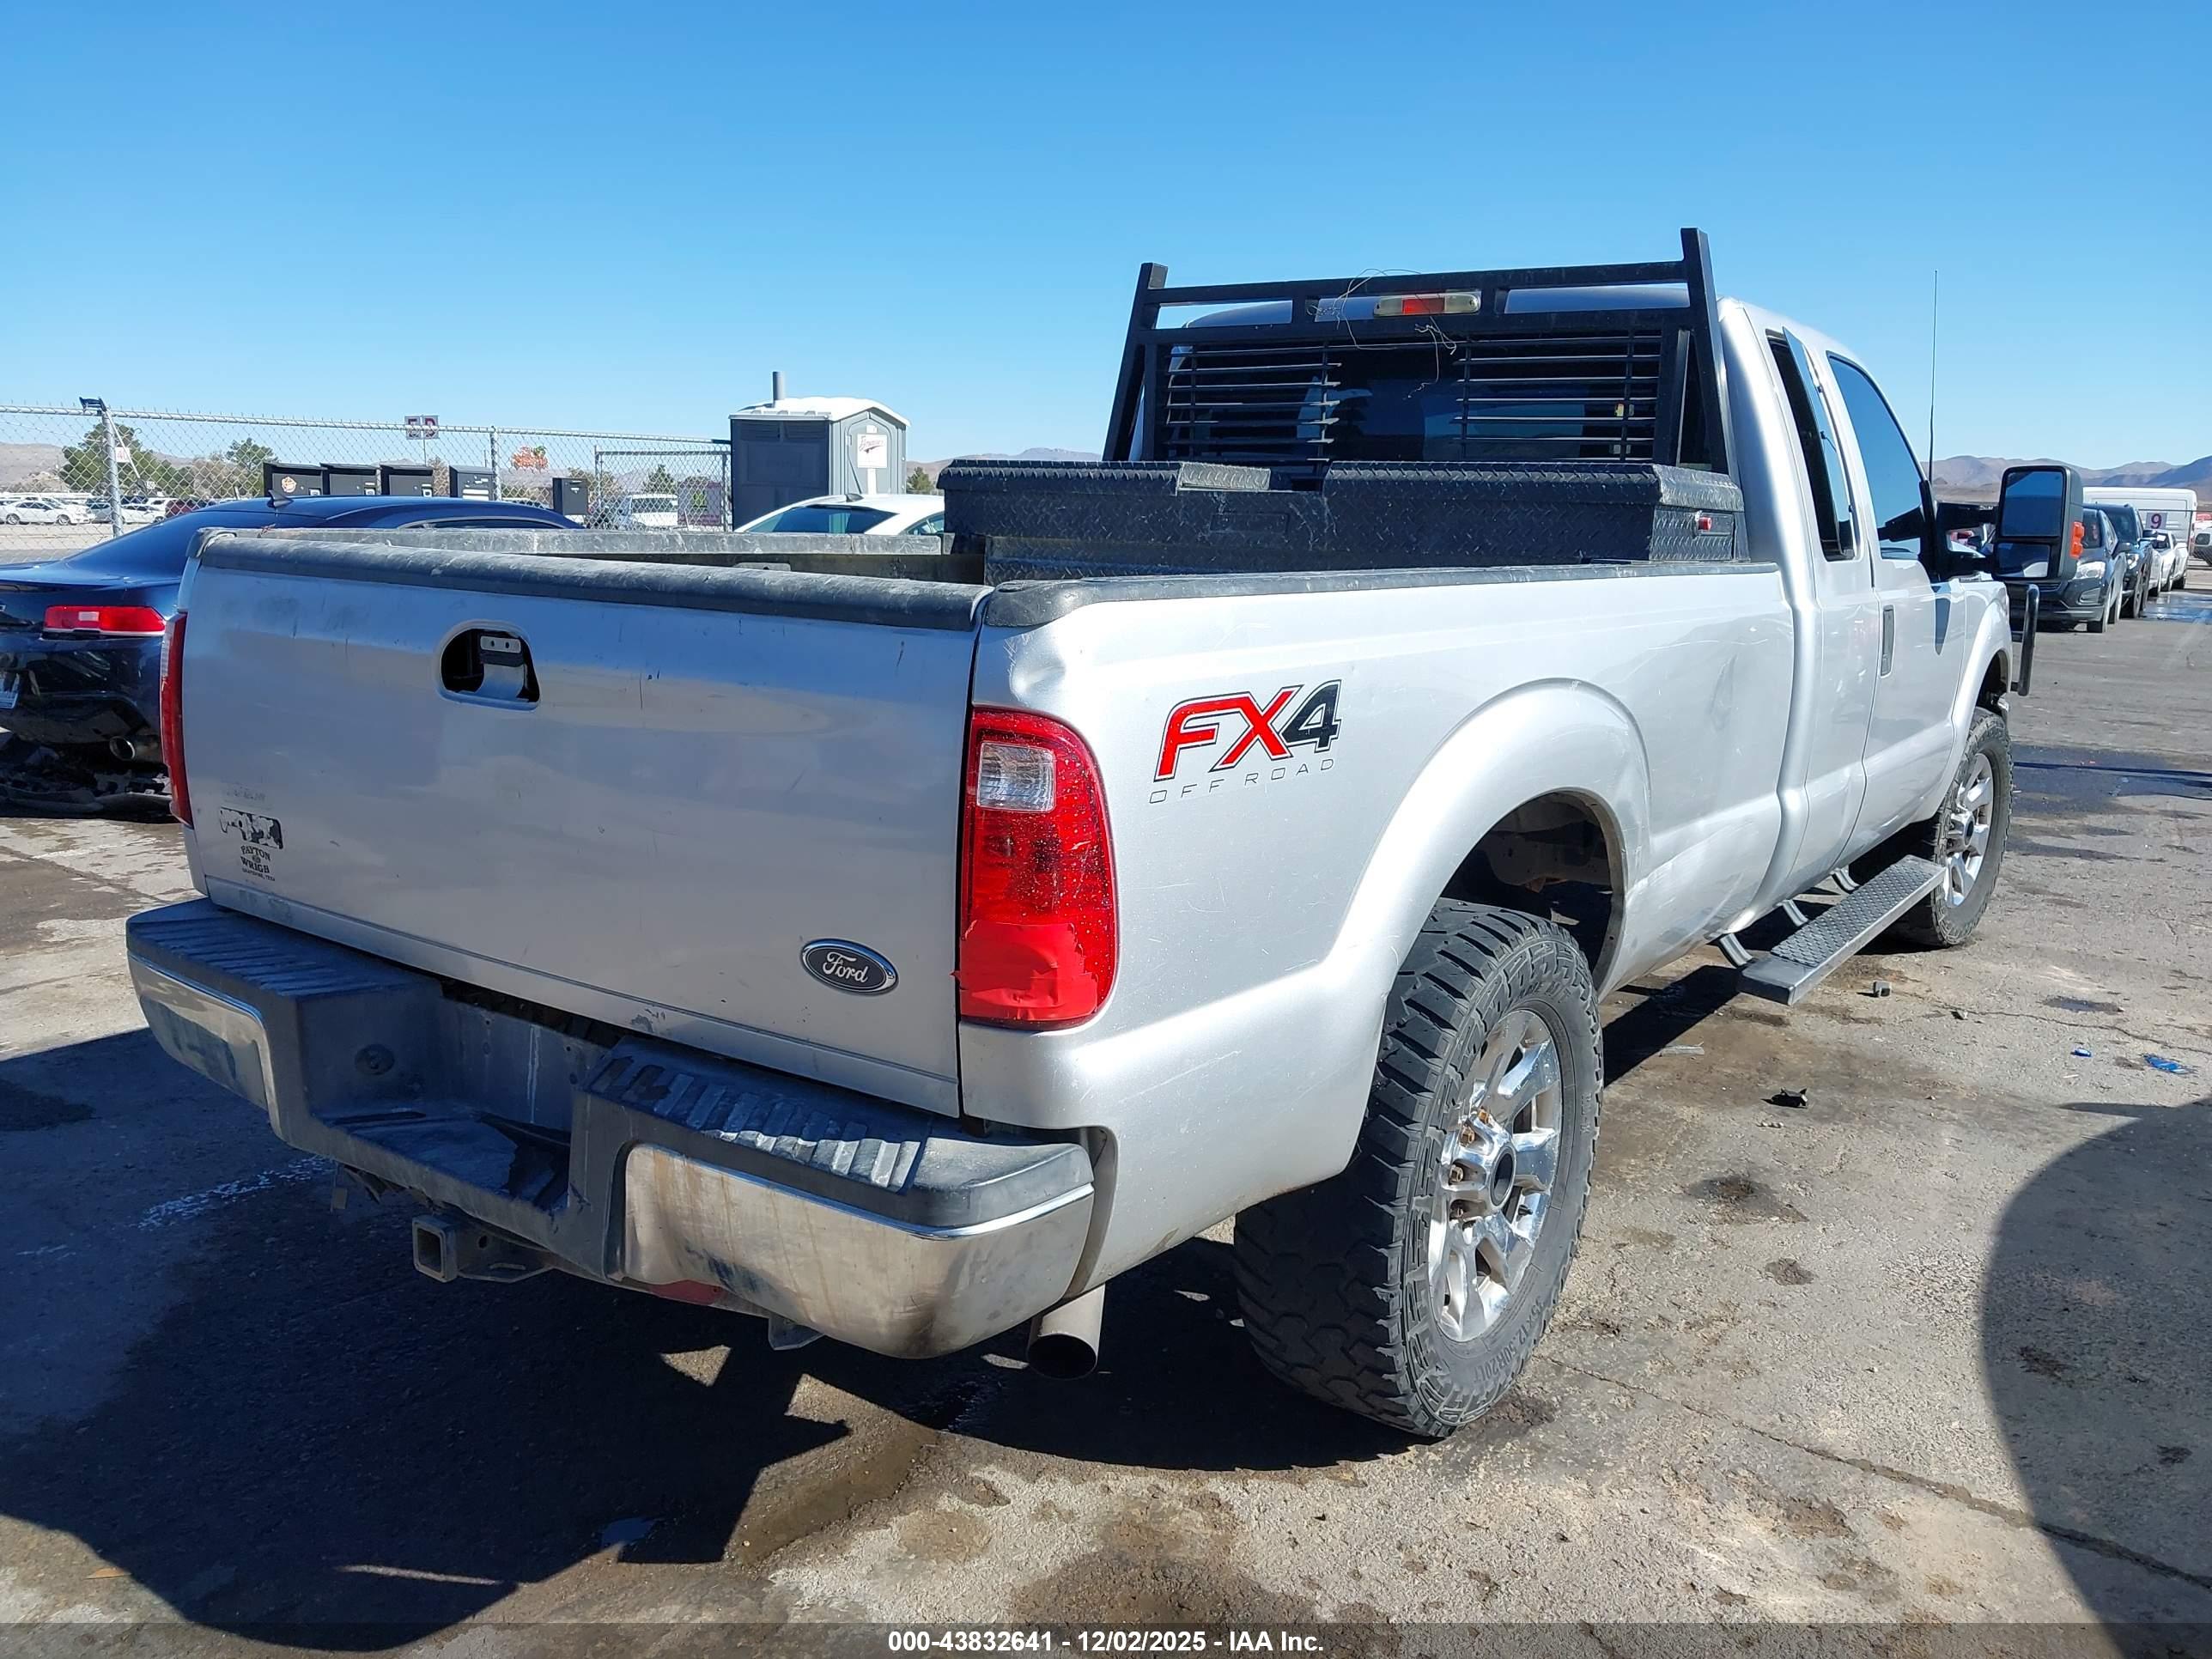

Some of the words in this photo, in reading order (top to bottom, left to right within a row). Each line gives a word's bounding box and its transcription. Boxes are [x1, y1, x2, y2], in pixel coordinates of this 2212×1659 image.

[2150, 514, 2162, 529] 9
[1153, 678, 1342, 782] FX4
[1148, 778, 1224, 805] OFF
[1244, 758, 1335, 786] ROAD
[240, 845, 270, 862] PAYTON
[822, 951, 868, 982] Ford
